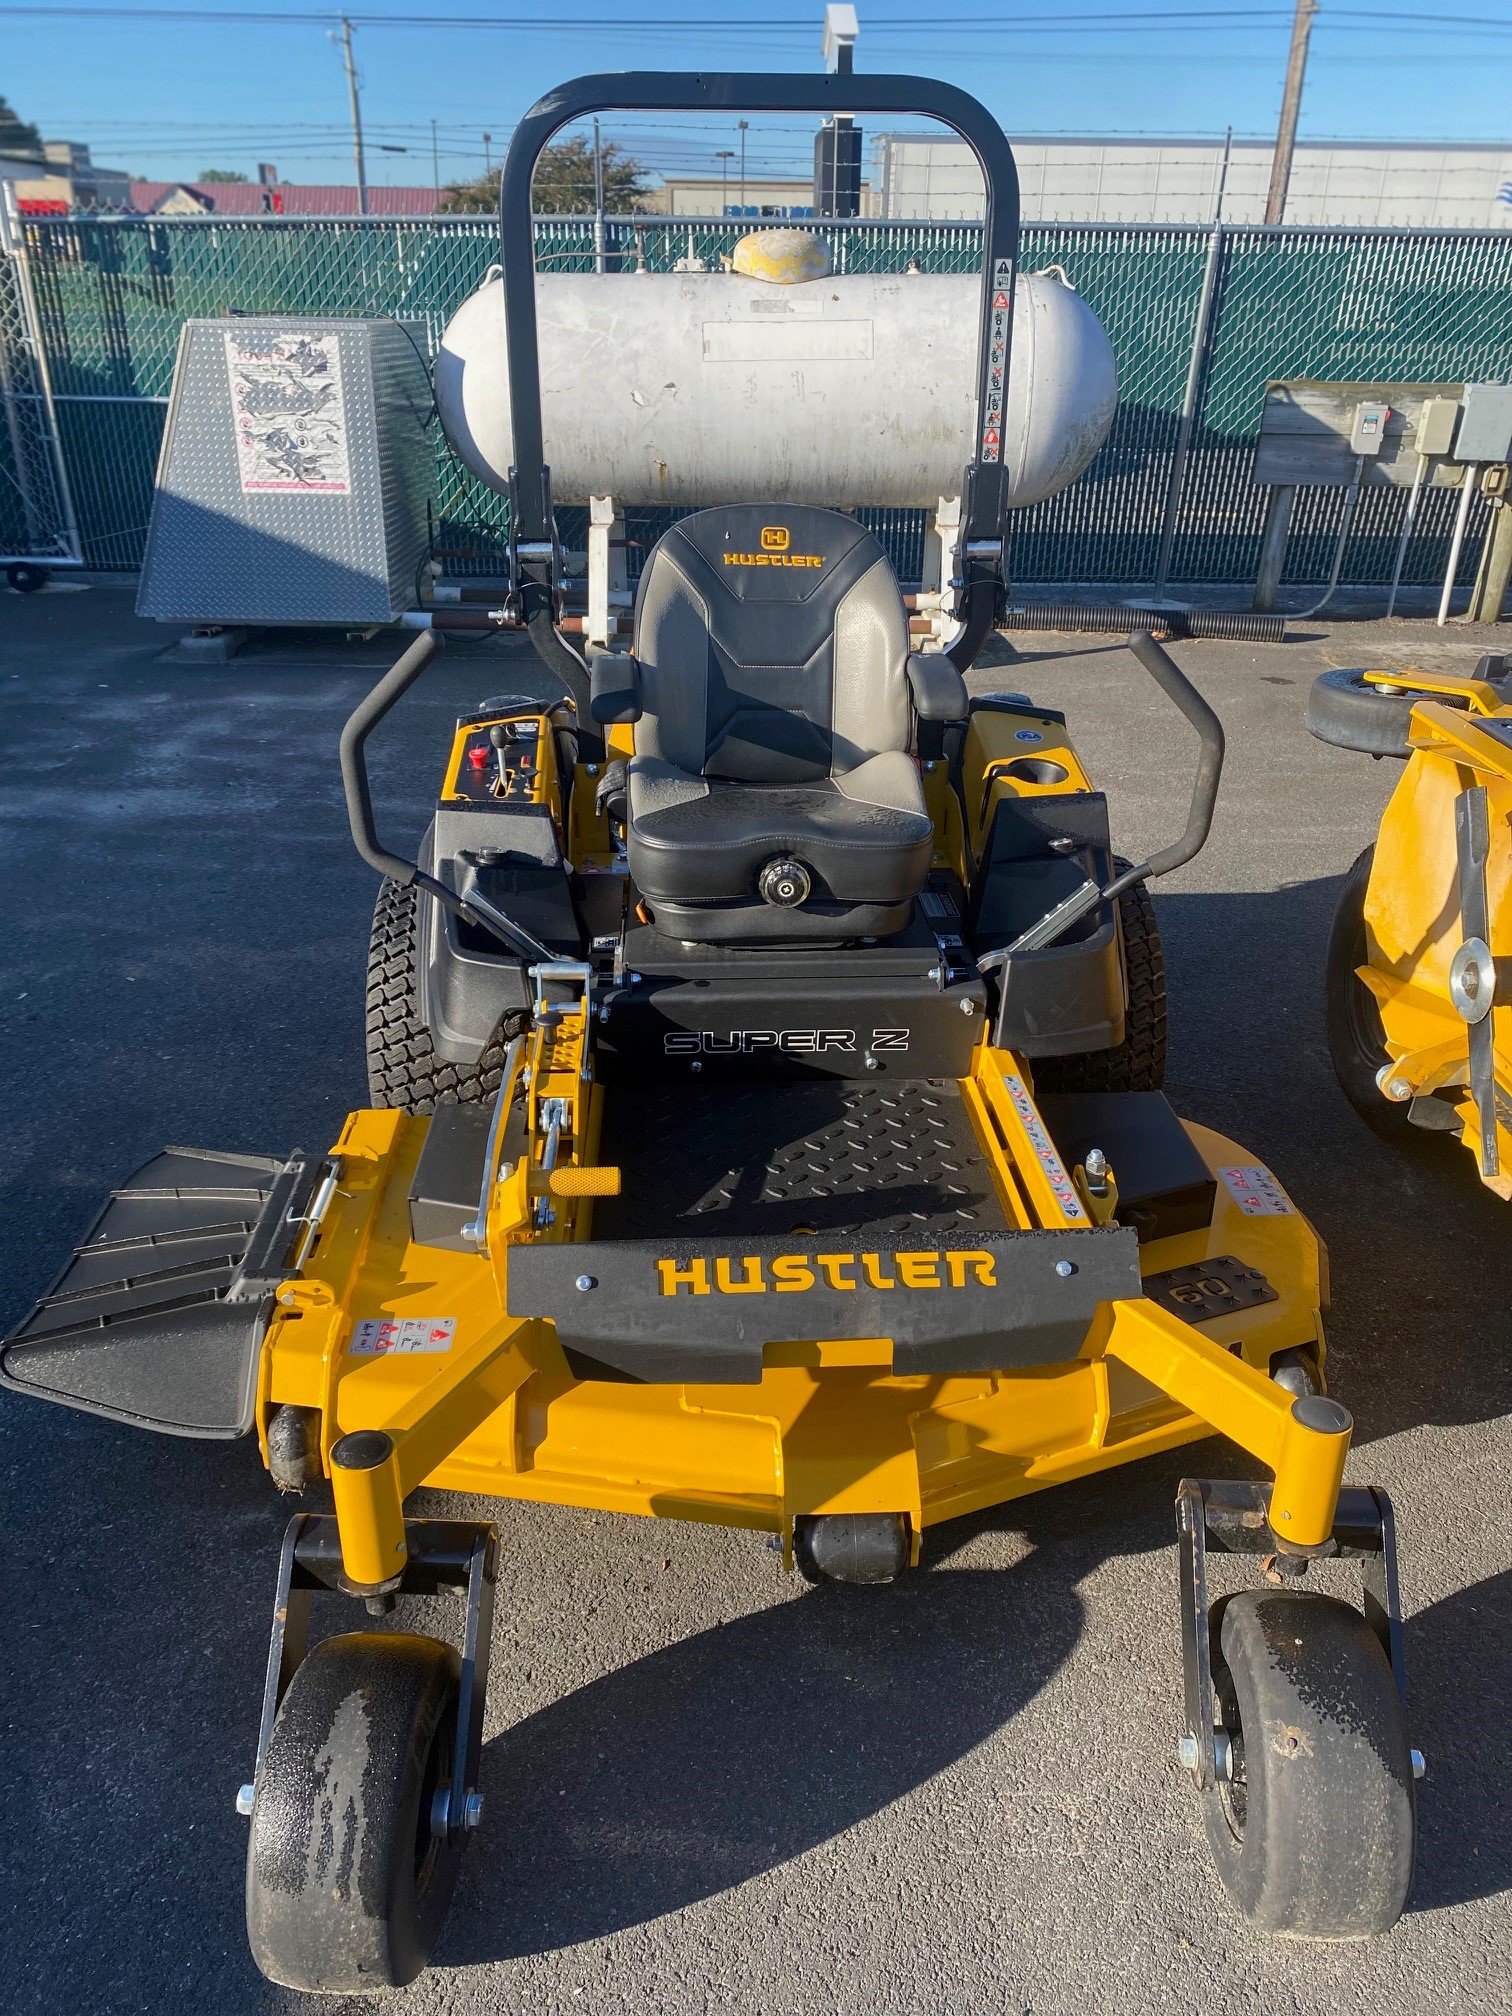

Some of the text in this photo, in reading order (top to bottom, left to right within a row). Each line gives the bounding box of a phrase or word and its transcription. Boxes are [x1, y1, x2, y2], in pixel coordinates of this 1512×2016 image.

[723, 553, 823, 568] HUSTLER
[664, 1028, 910, 1055] SUPER Z
[657, 1251, 997, 1296] HUSTLER
